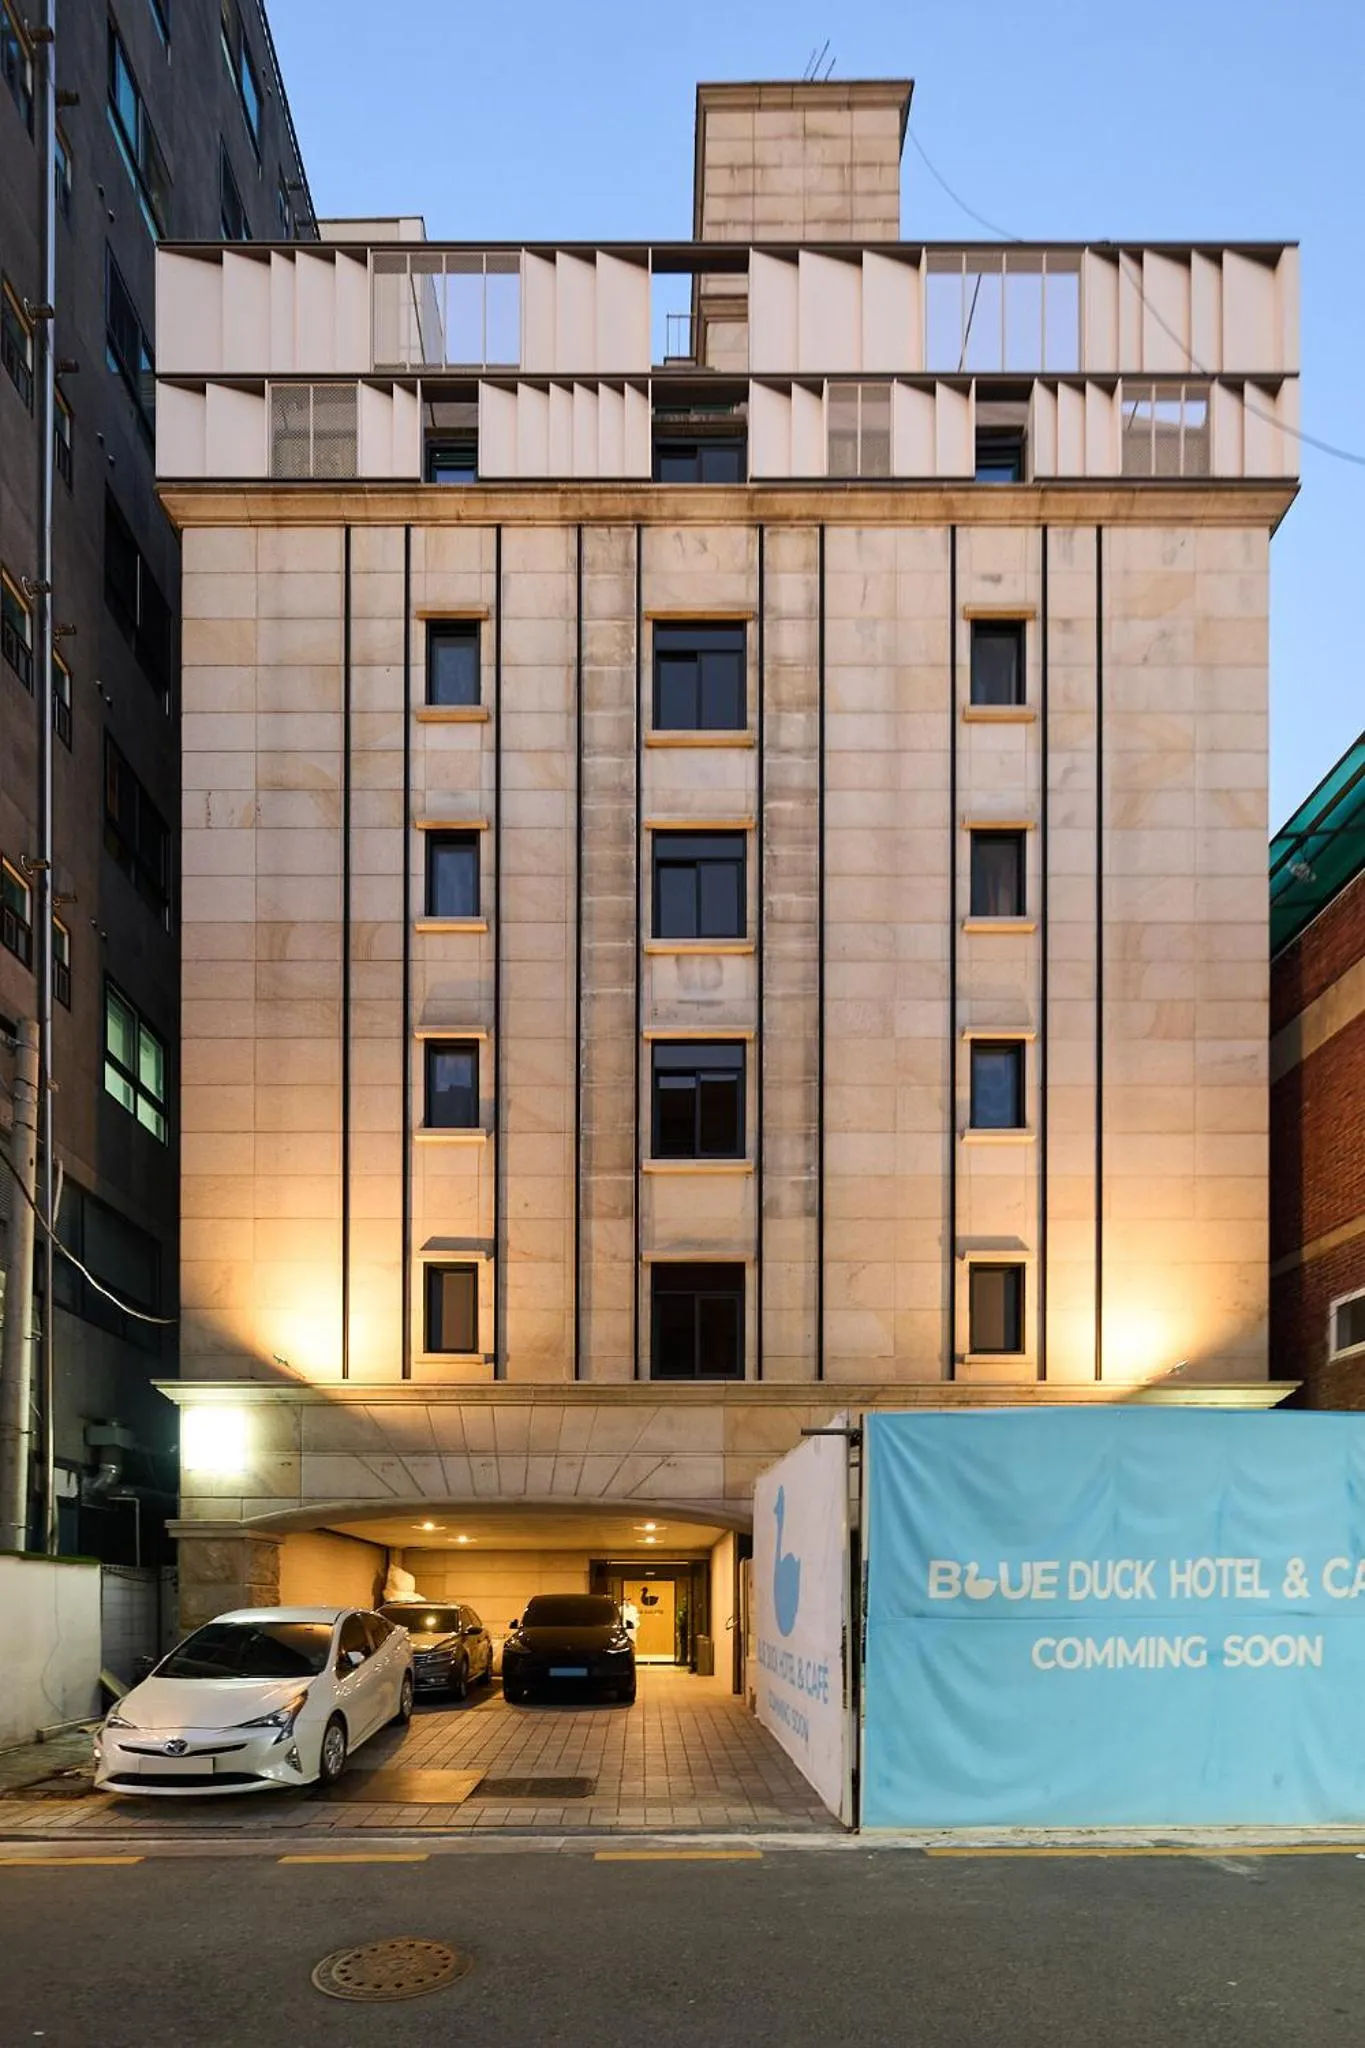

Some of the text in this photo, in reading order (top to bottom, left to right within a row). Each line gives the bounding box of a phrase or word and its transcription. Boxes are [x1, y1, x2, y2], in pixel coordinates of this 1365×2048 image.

[1068, 1559, 1158, 1600] DUCK
[1169, 1557, 1271, 1599] HOTEL
[1282, 1556, 1312, 1599] &
[1030, 1633, 1324, 1670] COMMING SOON
